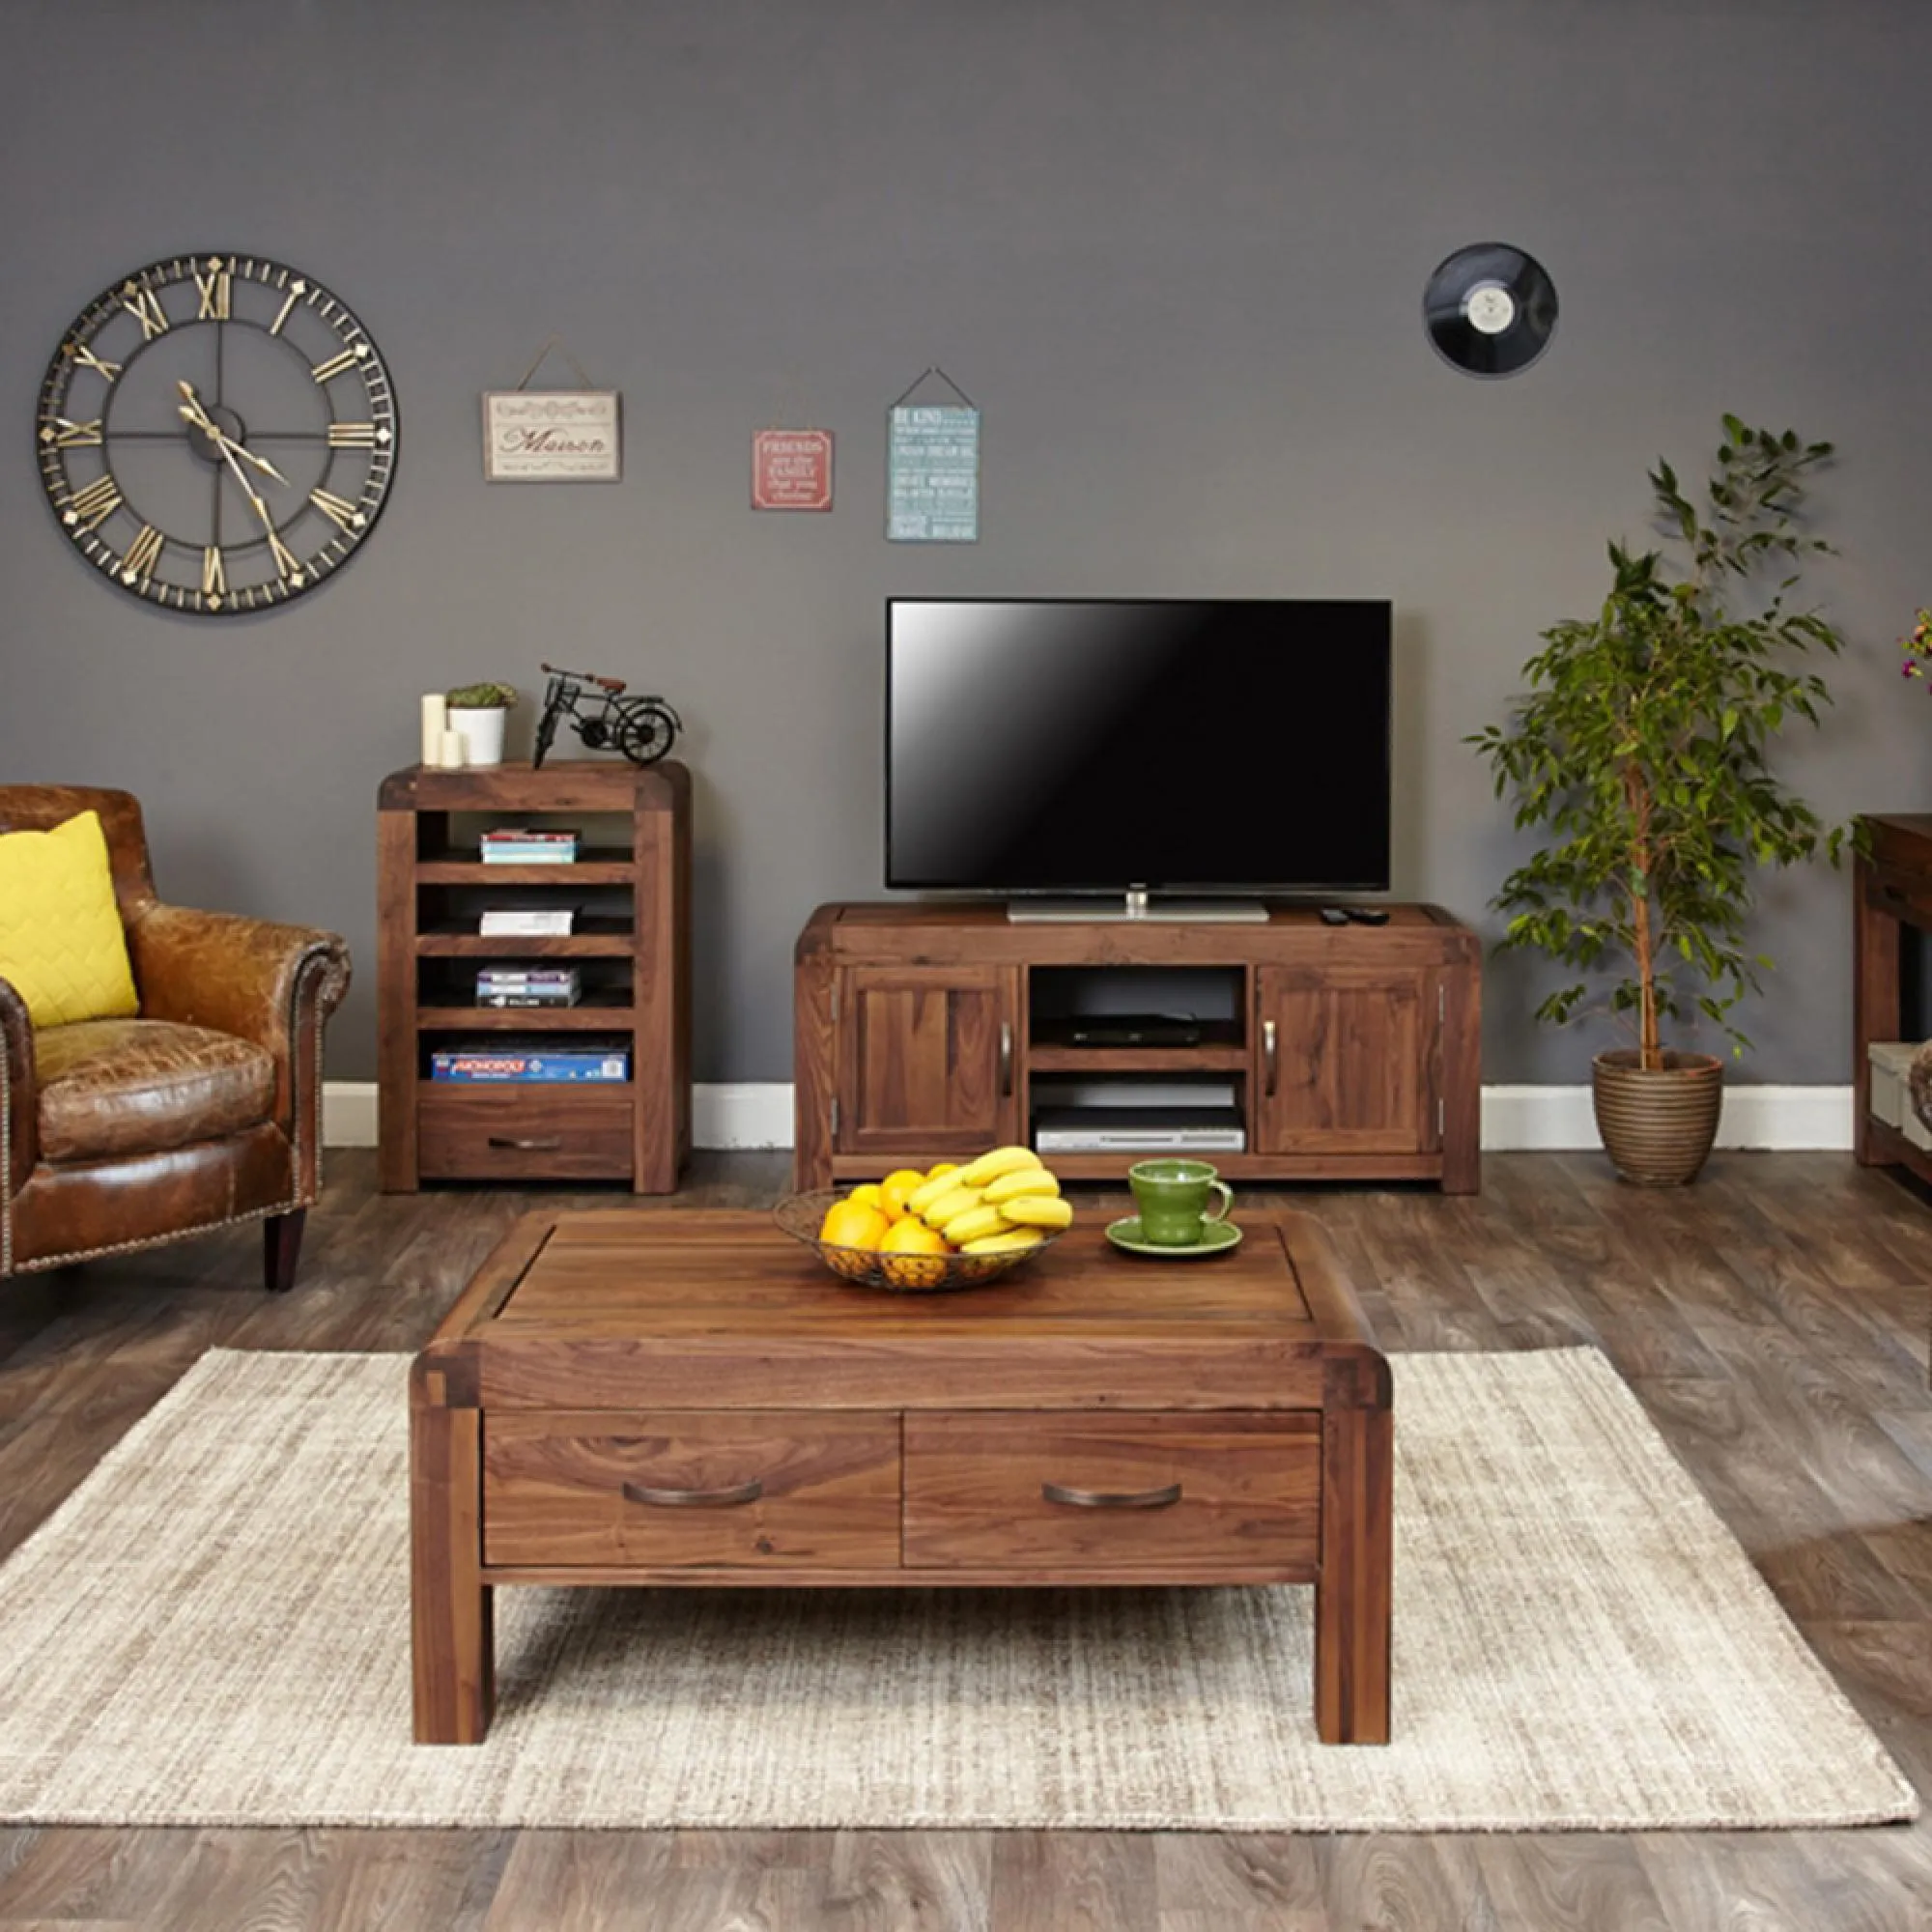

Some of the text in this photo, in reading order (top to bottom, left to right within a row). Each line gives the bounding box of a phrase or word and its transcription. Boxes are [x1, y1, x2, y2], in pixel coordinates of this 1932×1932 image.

[124, 290, 169, 340] XI
[73, 346, 122, 383] X
[56, 418, 103, 447] IX
[328, 422, 375, 447] III
